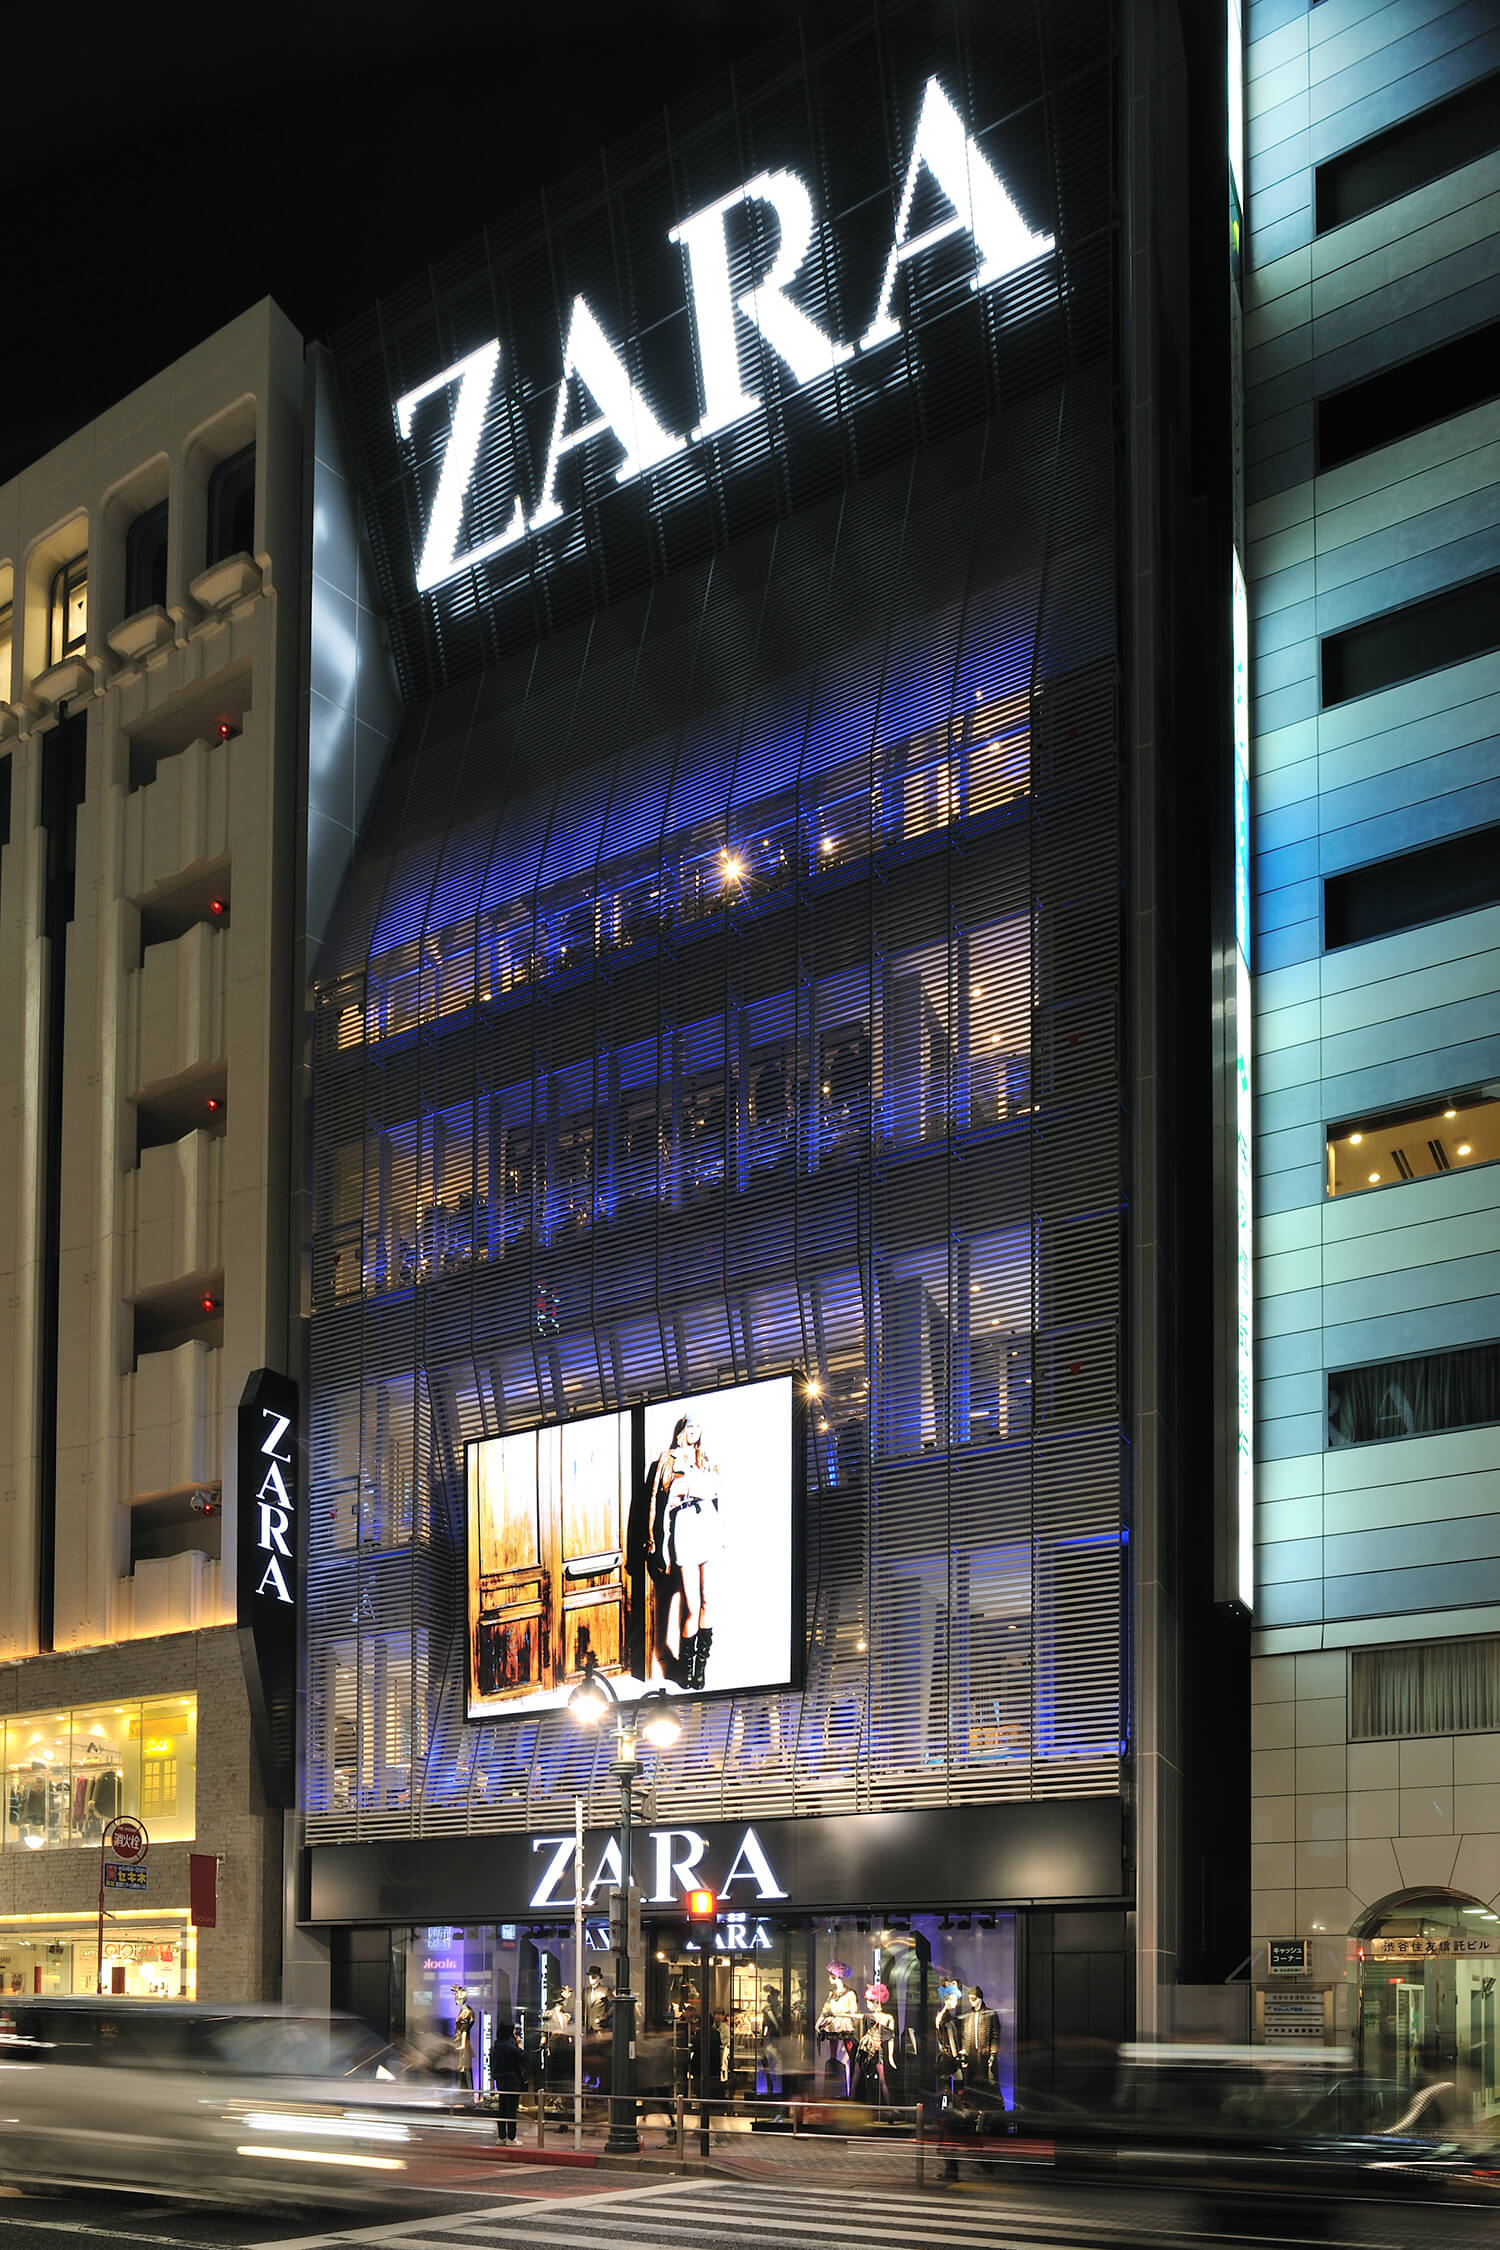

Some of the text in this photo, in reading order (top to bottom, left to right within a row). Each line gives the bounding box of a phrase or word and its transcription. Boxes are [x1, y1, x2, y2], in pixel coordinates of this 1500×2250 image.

[394, 74, 1056, 592] ZARA
[256, 1408, 295, 1604] ZARA
[113, 1833, 140, 1850] 消火栓
[529, 1827, 787, 1907] ZARA
[1272, 1947, 1303, 1955] キャッシュ
[1383, 1940, 1490, 1952] 渋谷住友信託ビル
[1272, 1955, 1303, 1963] コーナー
